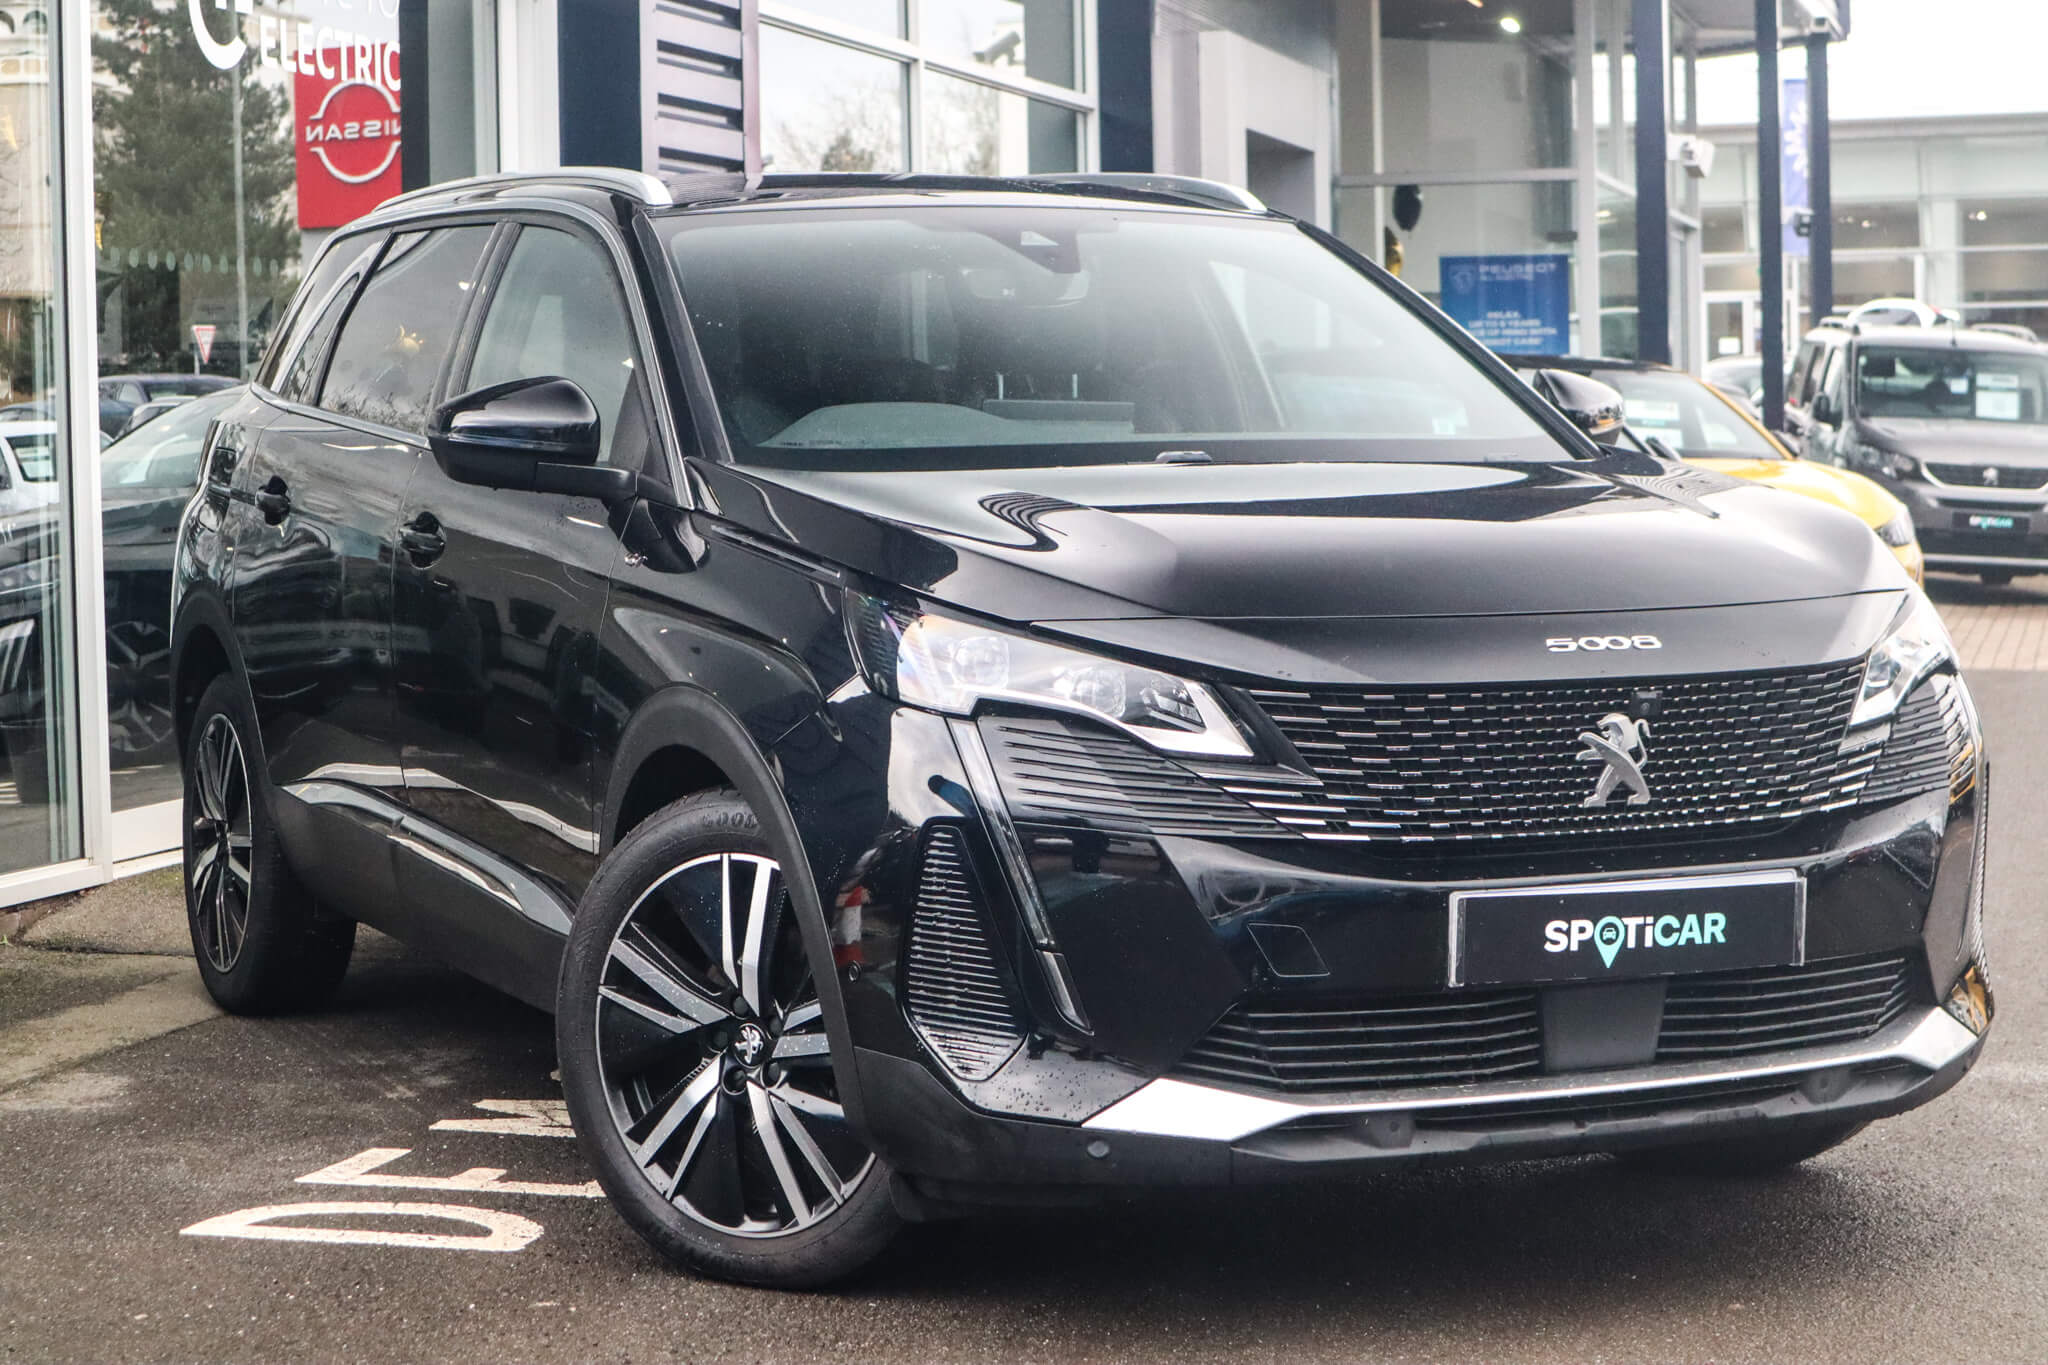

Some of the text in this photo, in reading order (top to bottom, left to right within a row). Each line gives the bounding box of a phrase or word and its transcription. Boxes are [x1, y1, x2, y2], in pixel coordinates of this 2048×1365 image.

[259, 14, 402, 92] ELECTRIC
[1478, 263, 1557, 273] PEUGEOT
[1545, 635, 1662, 652] 5008
